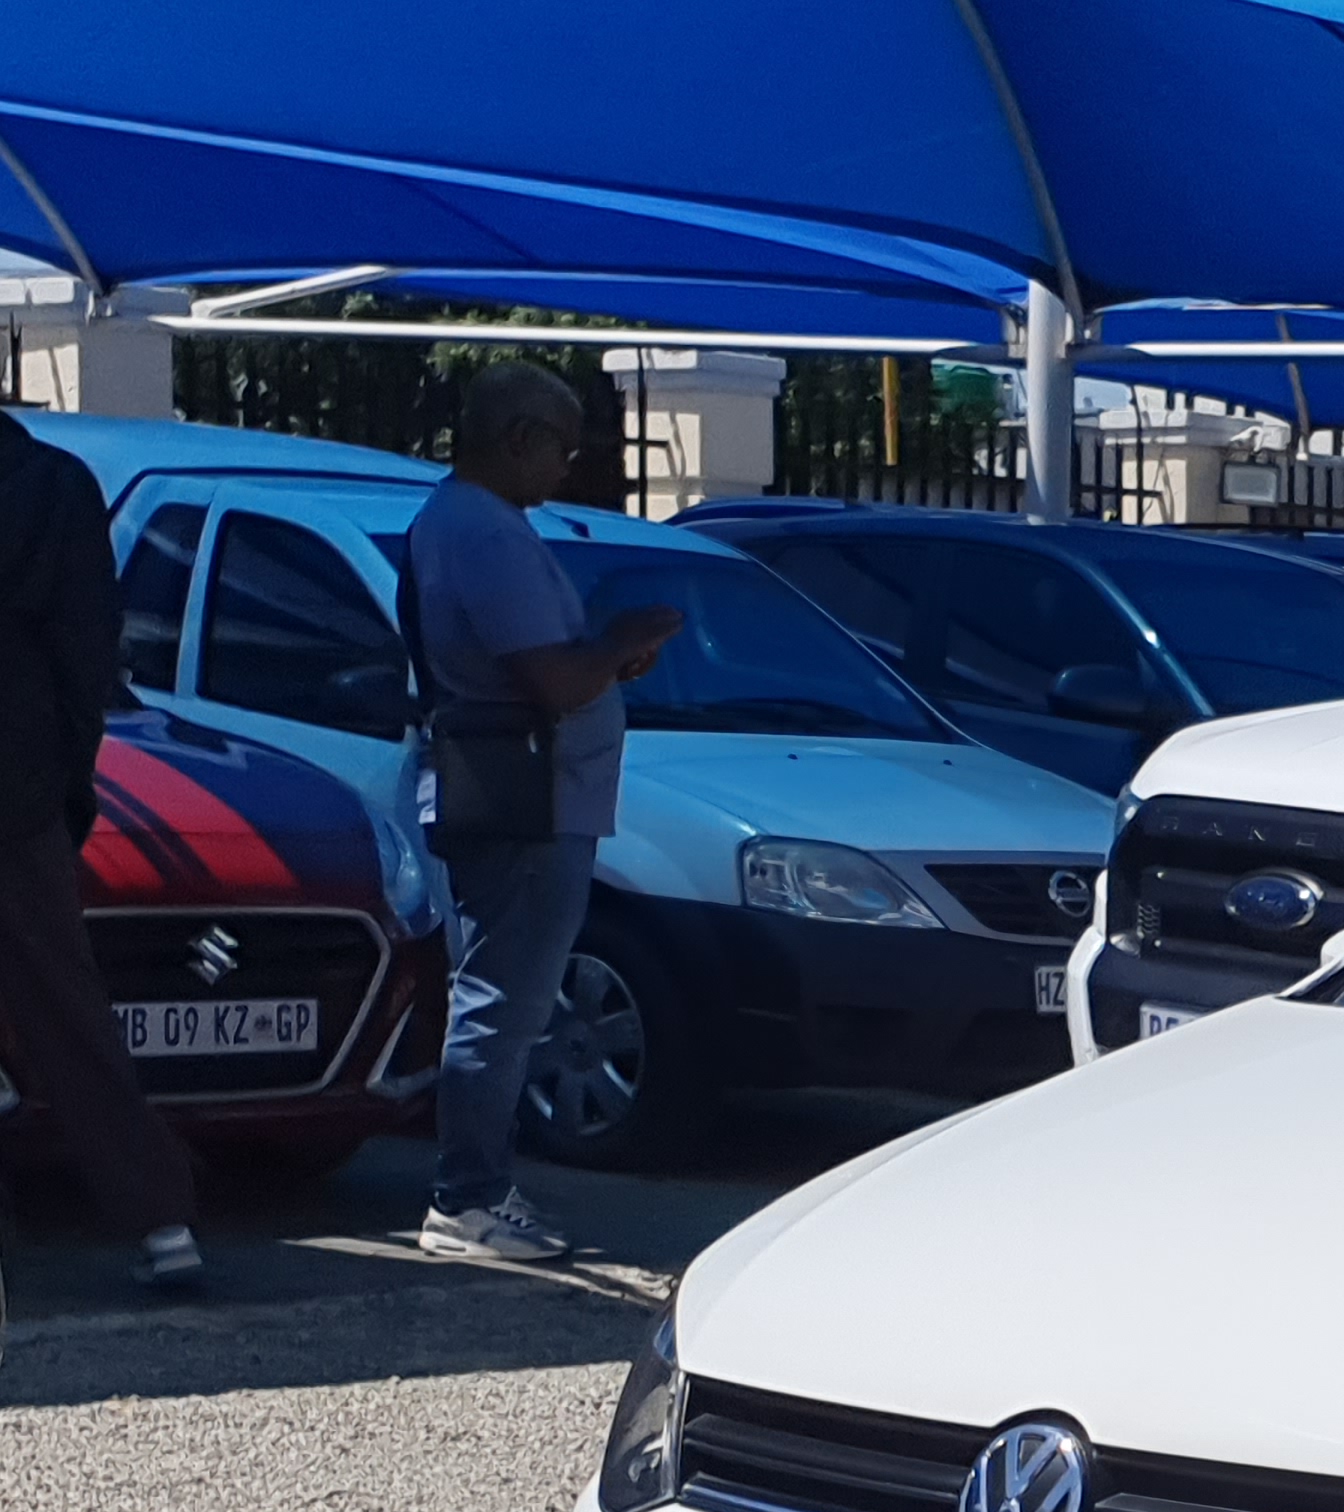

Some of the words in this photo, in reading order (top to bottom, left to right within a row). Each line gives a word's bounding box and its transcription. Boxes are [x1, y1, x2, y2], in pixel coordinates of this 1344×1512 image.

[164, 1007, 200, 1047] 09
[214, 1005, 250, 1045] KZ
[275, 1003, 311, 1042] GP
